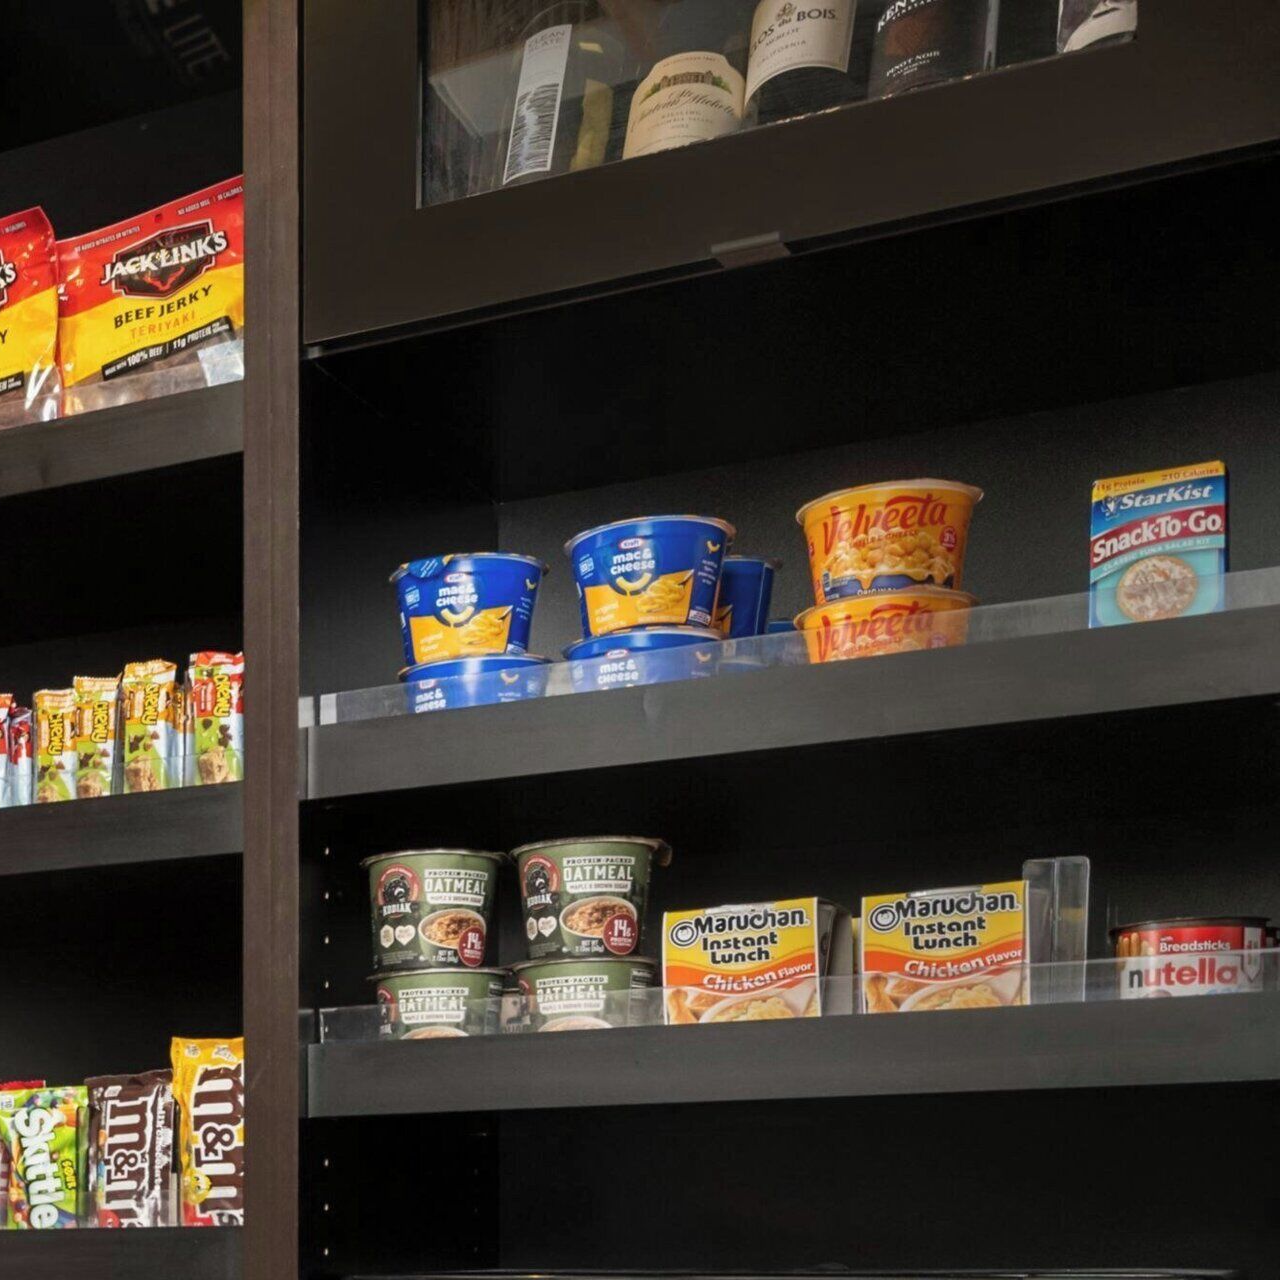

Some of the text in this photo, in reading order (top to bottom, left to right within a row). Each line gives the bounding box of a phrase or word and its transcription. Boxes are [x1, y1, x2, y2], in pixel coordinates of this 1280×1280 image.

[797, 9, 836, 22] BOIS
[100, 252, 156, 285] JACK
[114, 284, 213, 329] BEEF JERKY
[130, 310, 196, 339] TERIYAKI
[1120, 485, 1213, 510] StarKist
[823, 493, 948, 556] Velveeta
[564, 866, 633, 881] OATMEAL
[424, 878, 486, 895] OATMEAL
[896, 892, 1015, 918] Maruchan
[693, 908, 805, 934] Maruchan
[903, 916, 986, 935] Instant
[702, 931, 778, 952] Instant
[912, 933, 978, 951] Lunch
[1160, 940, 1231, 952] Breadsticks
[710, 948, 770, 965] Lunch
[904, 949, 1023, 978] Chicken Flavor
[702, 962, 813, 990] Chicken Flavor
[1129, 958, 1238, 988] nutella
[537, 988, 606, 1001] OATMEAL
